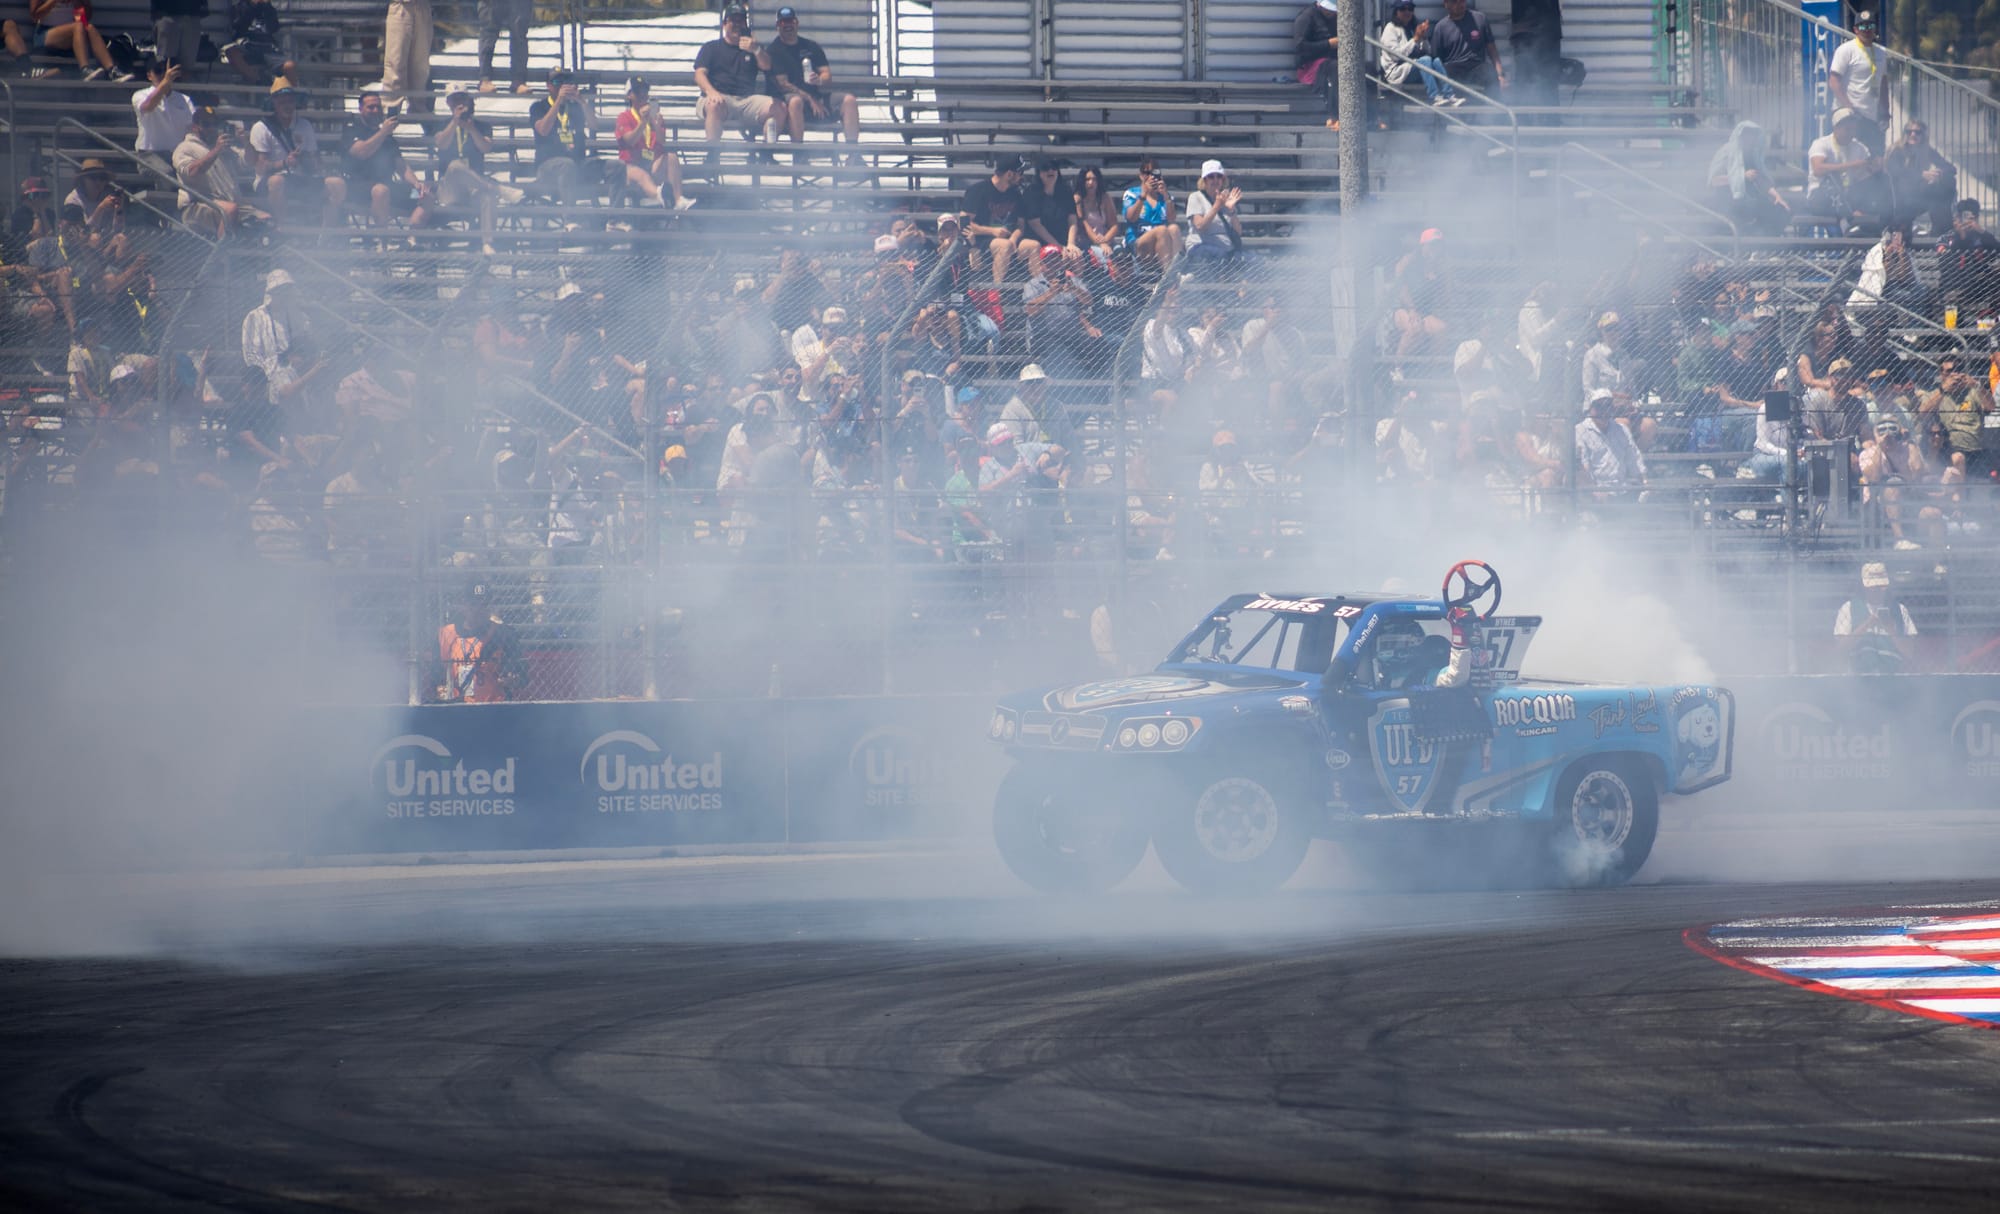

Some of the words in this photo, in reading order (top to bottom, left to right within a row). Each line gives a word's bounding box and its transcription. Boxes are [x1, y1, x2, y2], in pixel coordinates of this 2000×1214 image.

[1243, 598, 1325, 612] HYNES
[1333, 606, 1361, 618] 57
[1486, 629, 1515, 668] 57
[1774, 721, 1890, 760] United
[385, 757, 515, 796] United
[597, 751, 723, 791] United
[1396, 775, 1422, 794] 57
[387, 801, 425, 818] SITE
[429, 799, 515, 816] SERVICES
[598, 795, 635, 813] SITE
[640, 793, 722, 811] SERVICES
